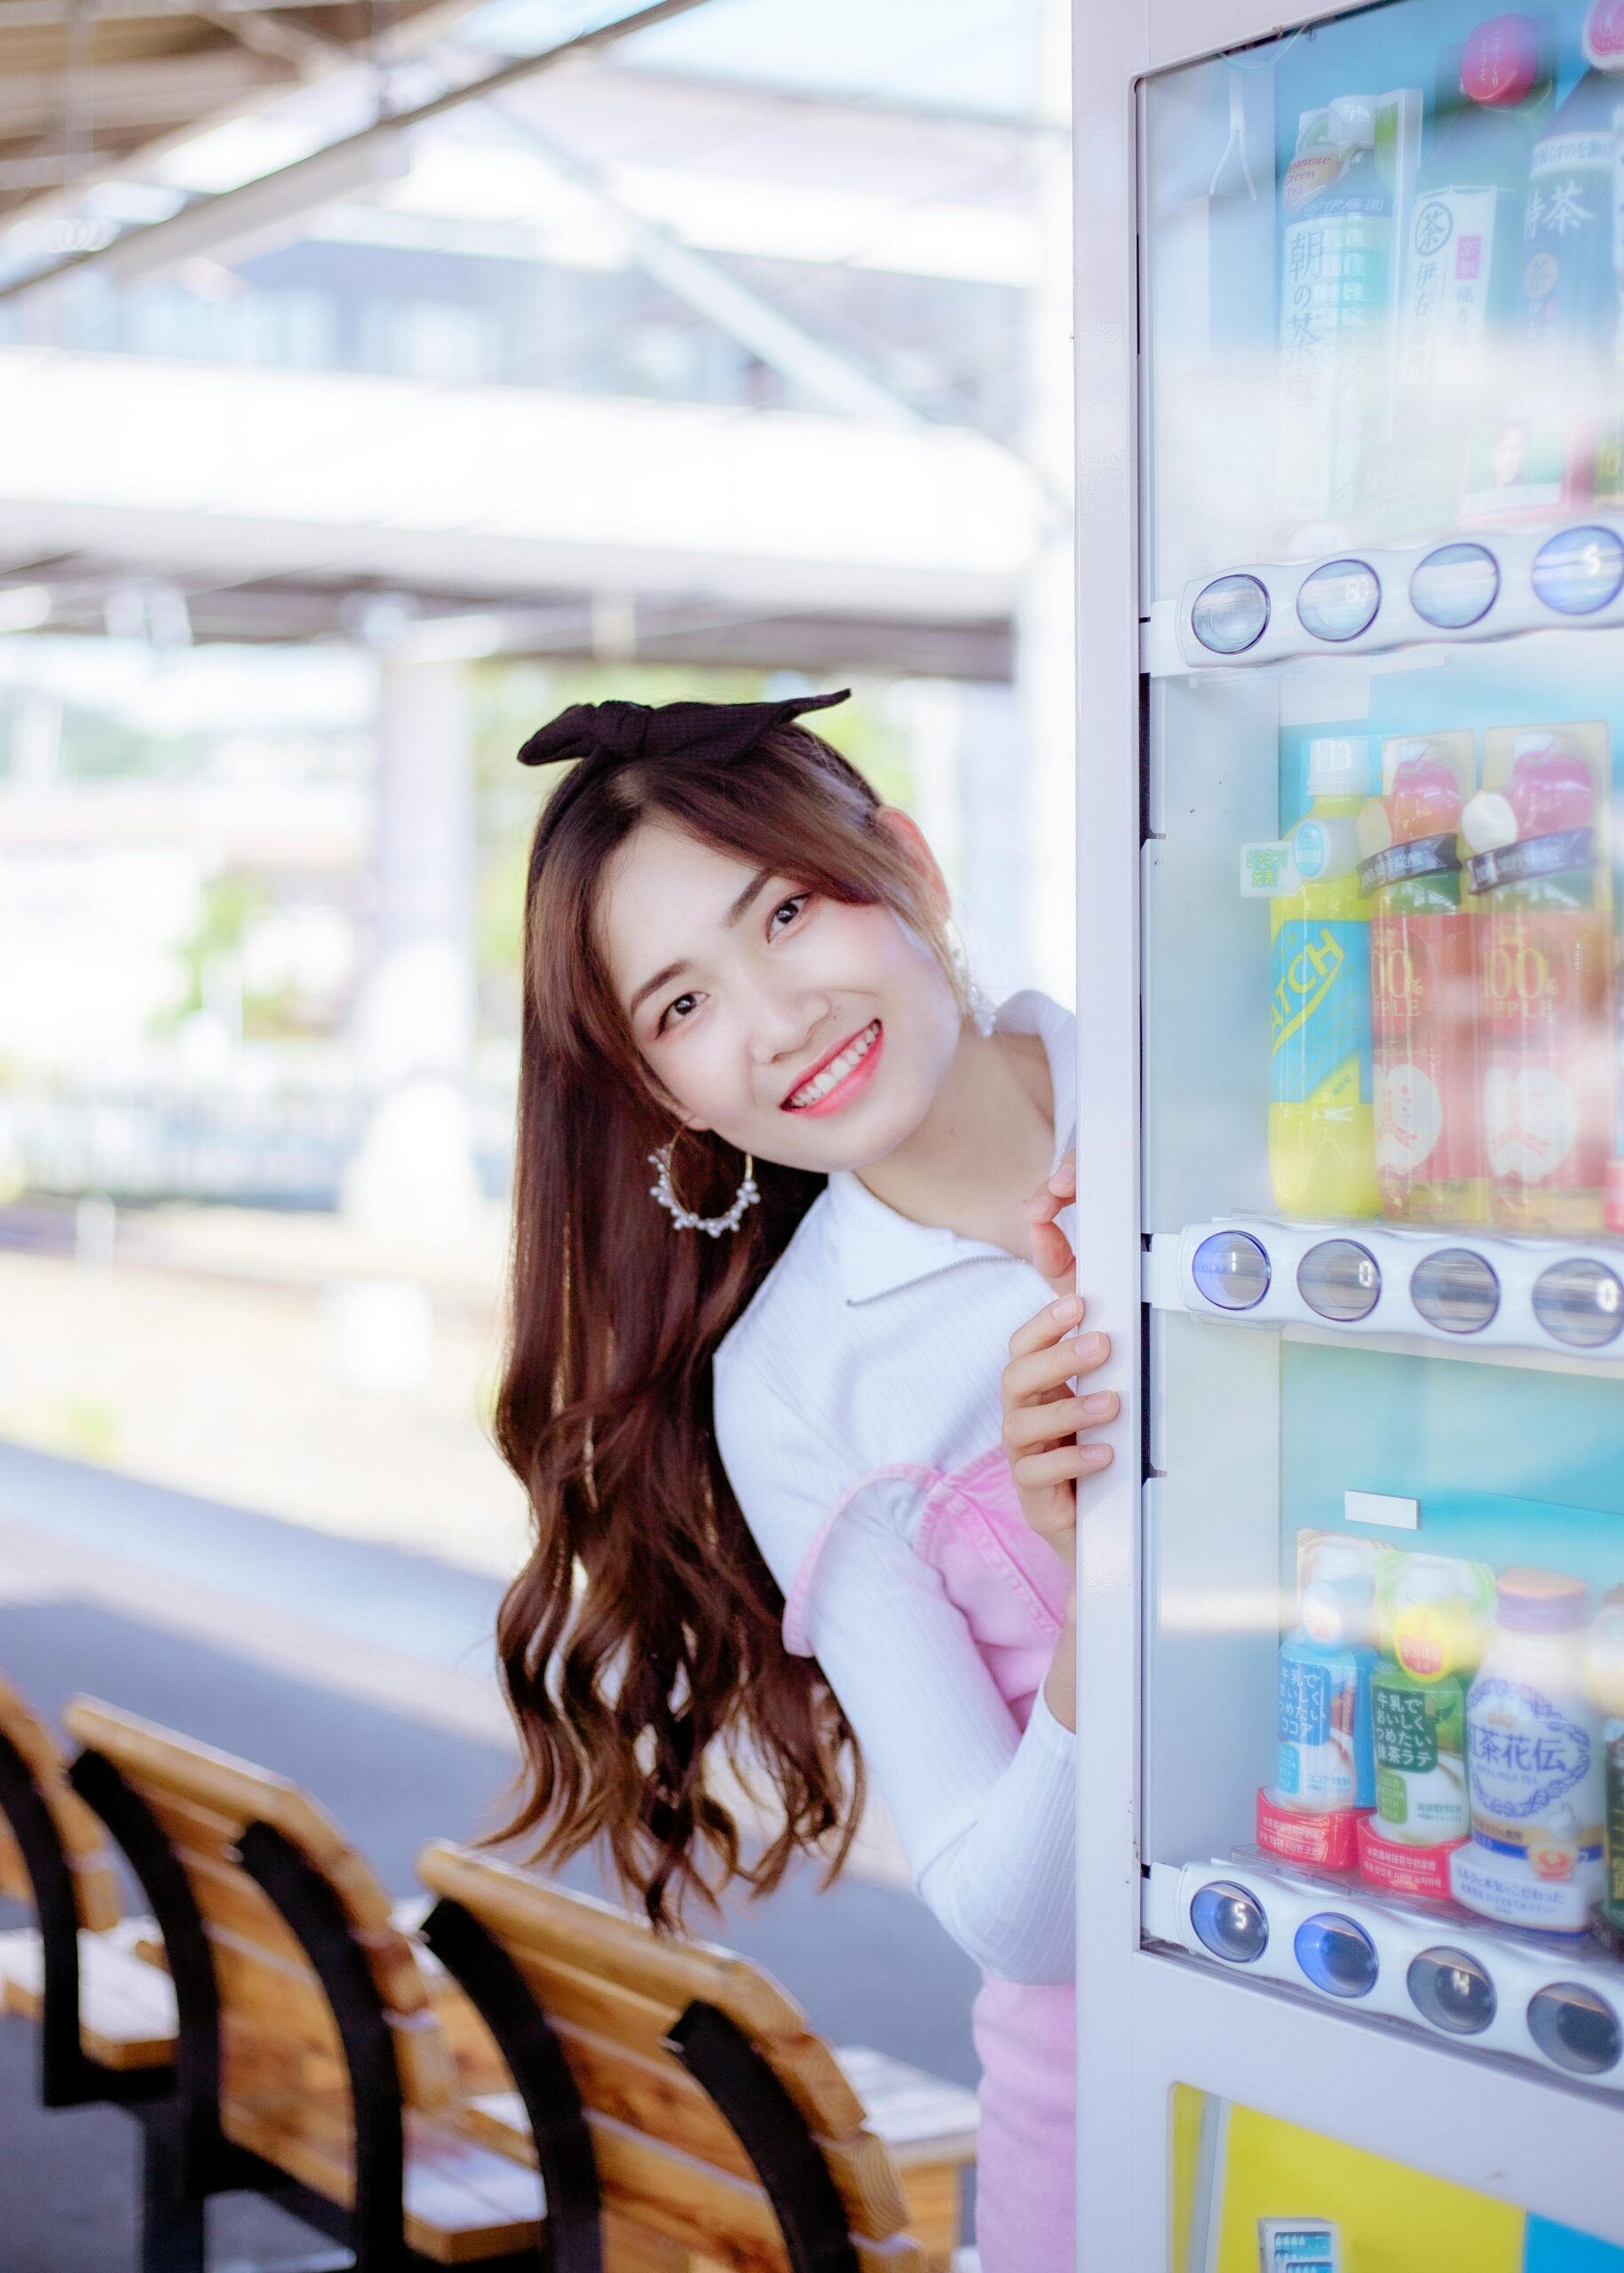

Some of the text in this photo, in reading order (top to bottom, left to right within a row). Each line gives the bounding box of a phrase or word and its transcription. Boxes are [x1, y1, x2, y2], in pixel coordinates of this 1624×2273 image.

[1421, 210, 1446, 250] 茶
[1456, 240, 1477, 278] 京都
[1371, 948, 1423, 998] 00%
[1271, 927, 1345, 1044] ATCH
[1374, 1000, 1421, 1017] PPLE
[1377, 1691, 1422, 1714] 牛乳で
[1281, 1718, 1314, 1737] ココア
[1375, 1709, 1425, 1731] おいしく
[1375, 1727, 1432, 1747] つめたい
[1376, 1744, 1432, 1768] 抹茶ラテ
